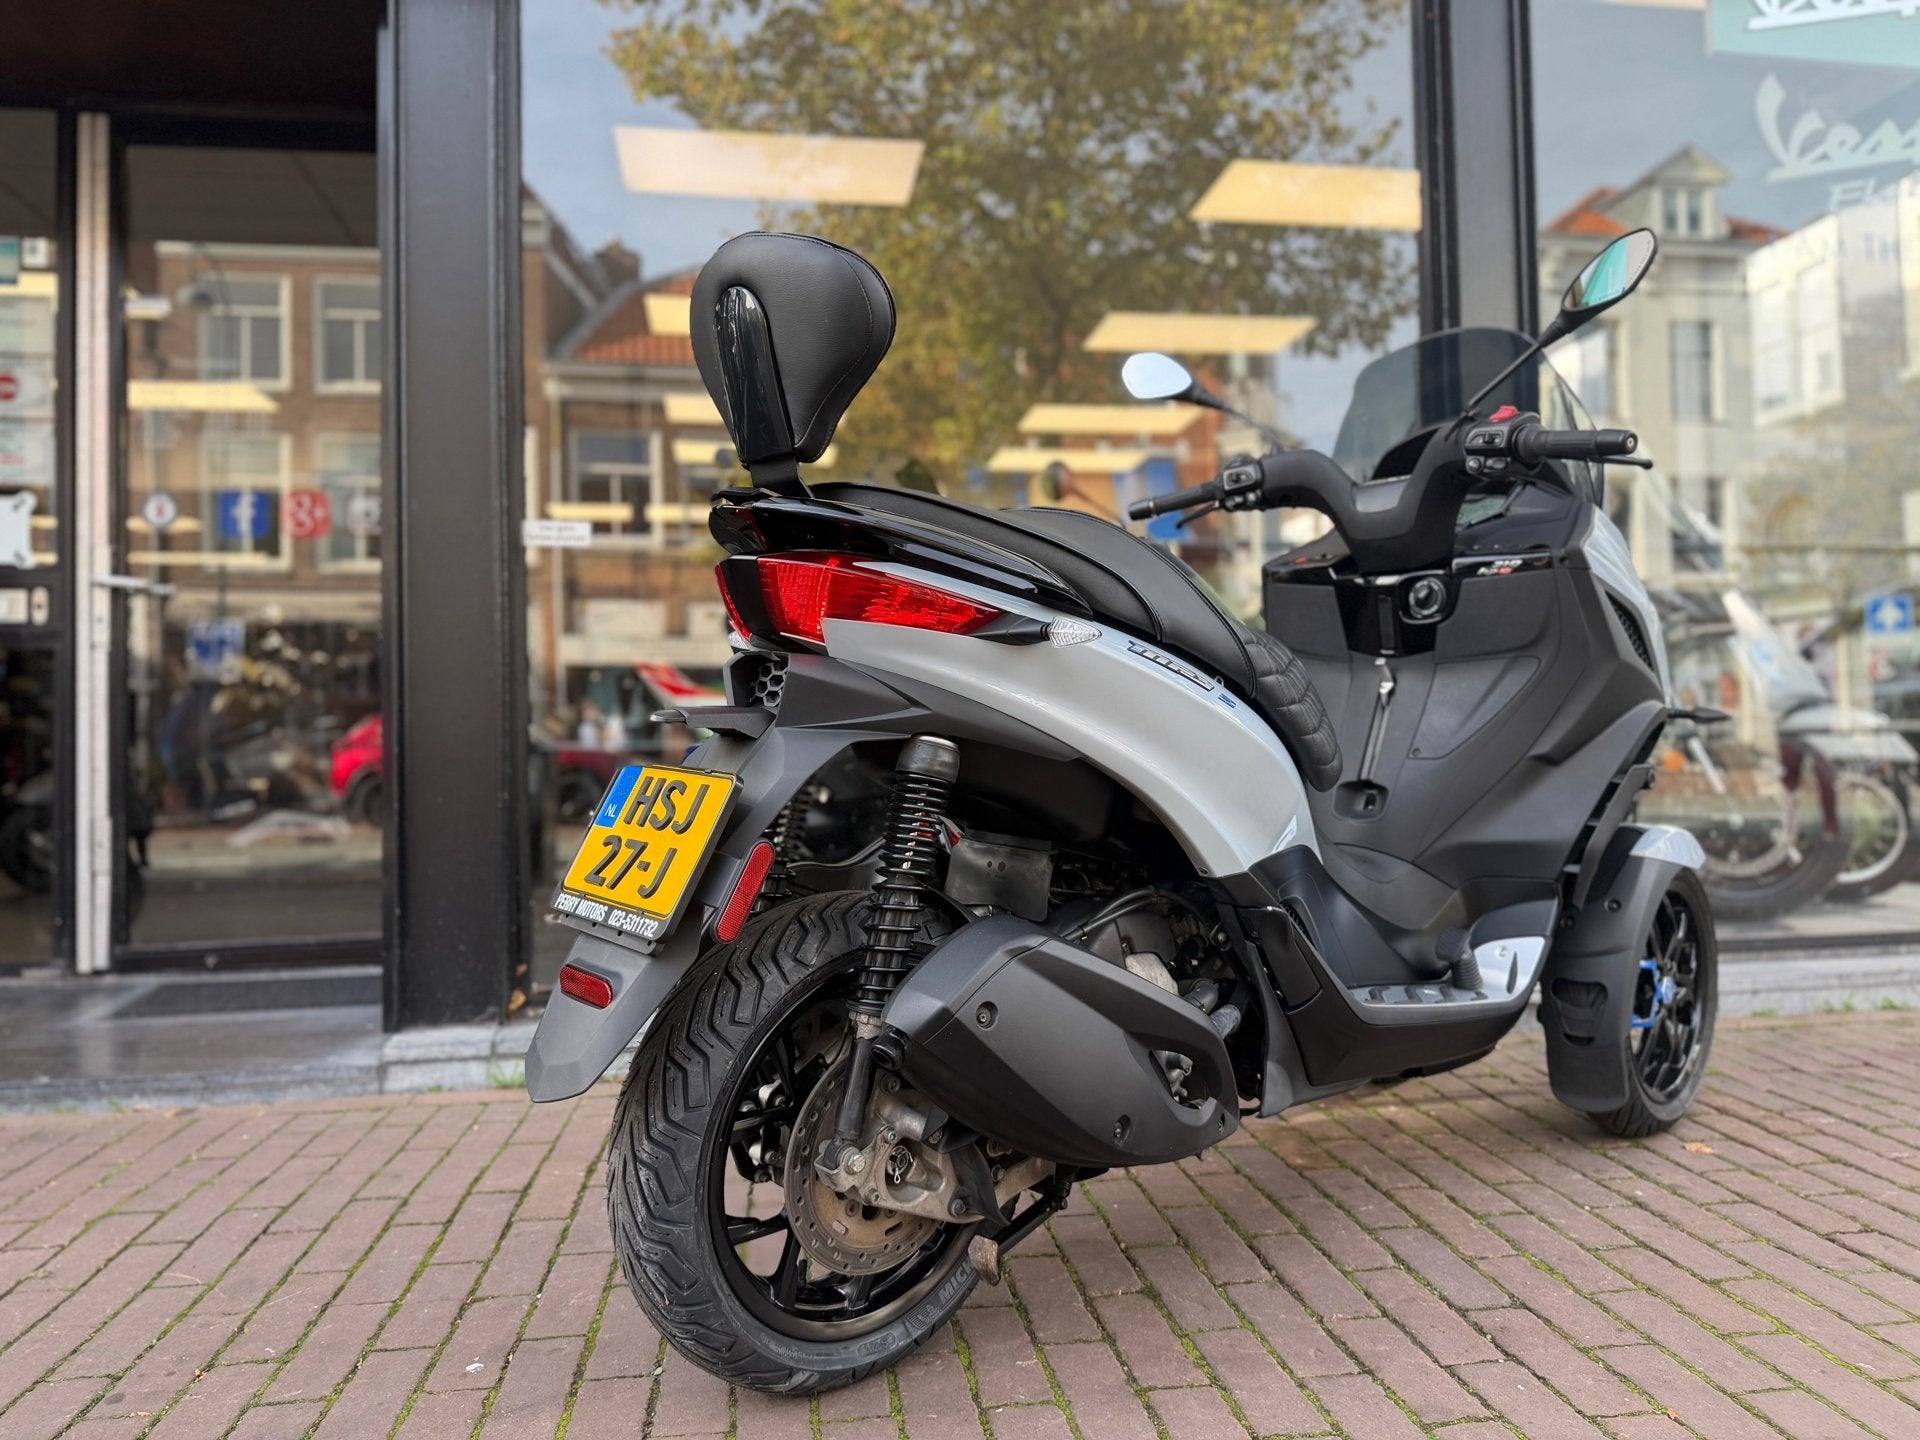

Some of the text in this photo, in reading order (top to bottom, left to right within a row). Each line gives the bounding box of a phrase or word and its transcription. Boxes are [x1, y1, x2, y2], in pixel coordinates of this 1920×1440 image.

[604, 803, 617, 818] NL
[624, 777, 709, 834] HSJ
[585, 835, 677, 898] 27-J
[554, 892, 659, 938] PERRY MOTORS 023-5311732
